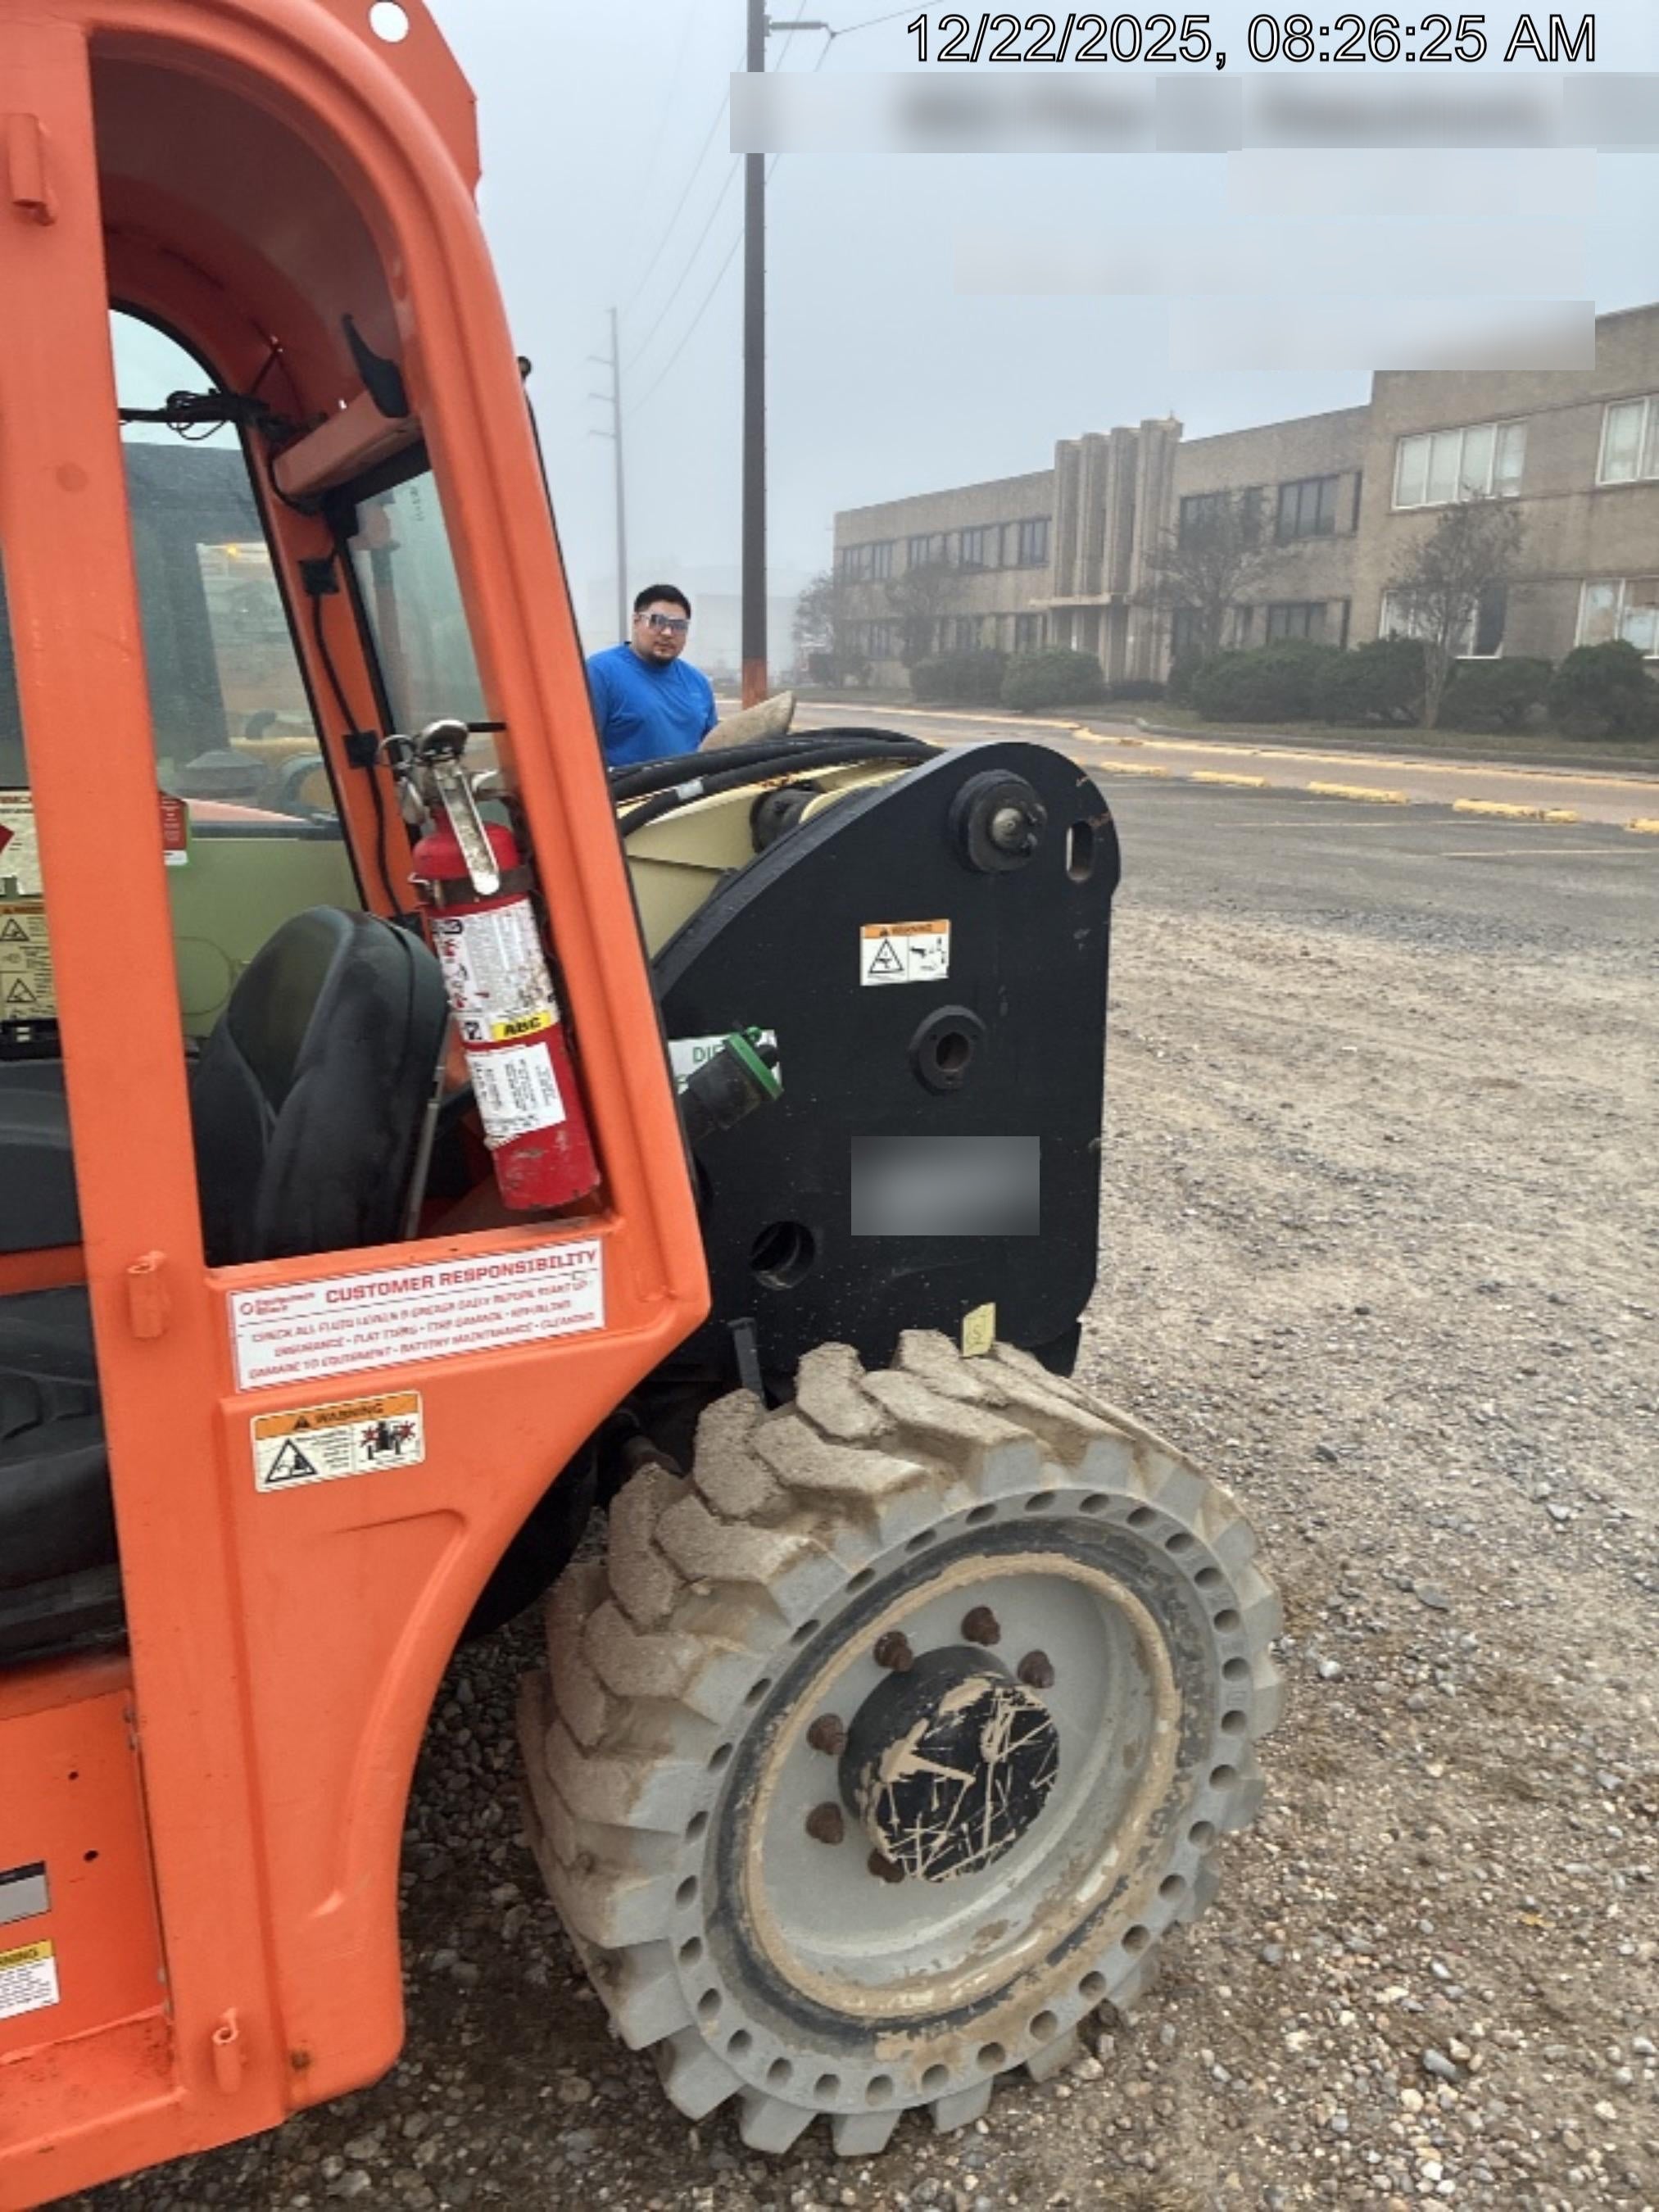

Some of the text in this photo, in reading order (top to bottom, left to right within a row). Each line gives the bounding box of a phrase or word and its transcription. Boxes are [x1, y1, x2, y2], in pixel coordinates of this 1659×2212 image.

[504, 1017, 541, 1036] ABC
[325, 1250, 596, 1303] CUSTOMER RESPONSIBILITY
[316, 1403, 383, 1424] WARNING
